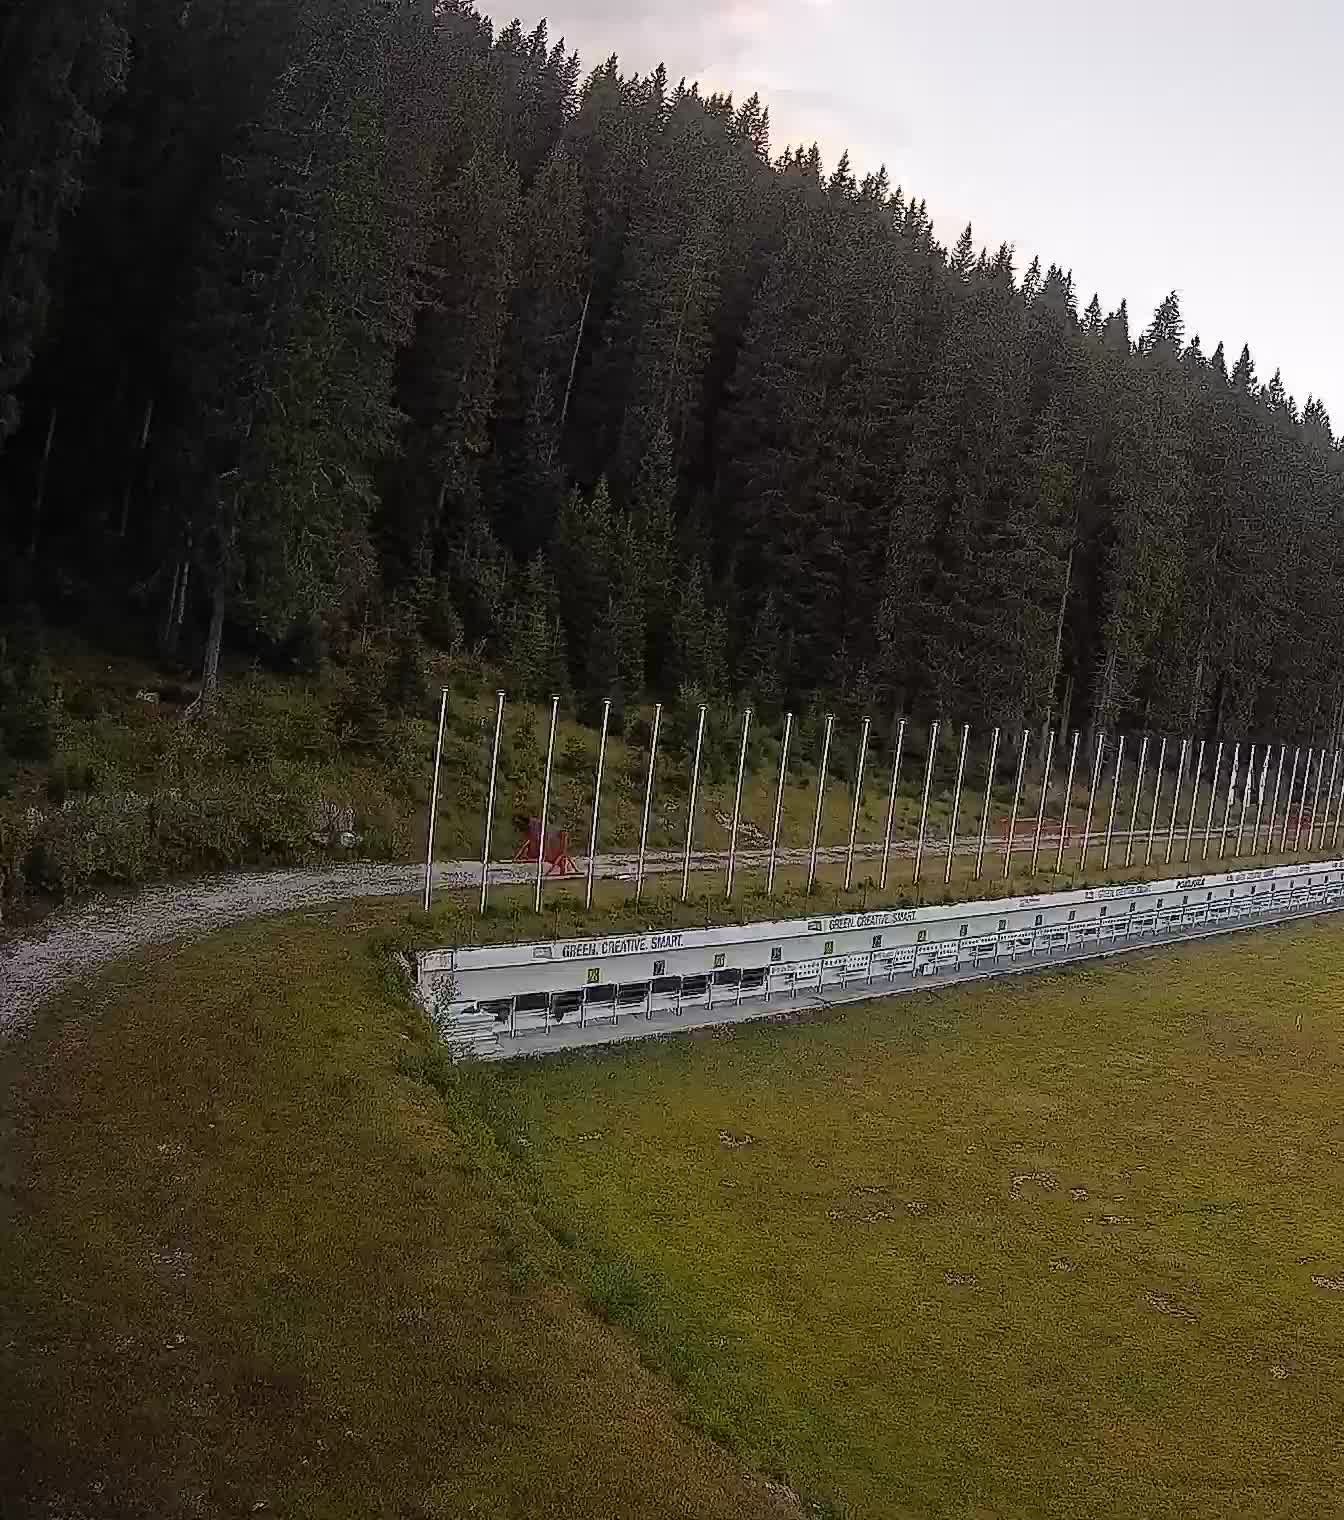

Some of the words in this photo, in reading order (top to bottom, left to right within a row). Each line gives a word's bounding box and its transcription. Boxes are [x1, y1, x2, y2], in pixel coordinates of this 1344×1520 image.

[562, 943, 599, 958] GREEN.
[601, 937, 649, 954] CREATIVE.
[651, 934, 684, 950] SMART.
